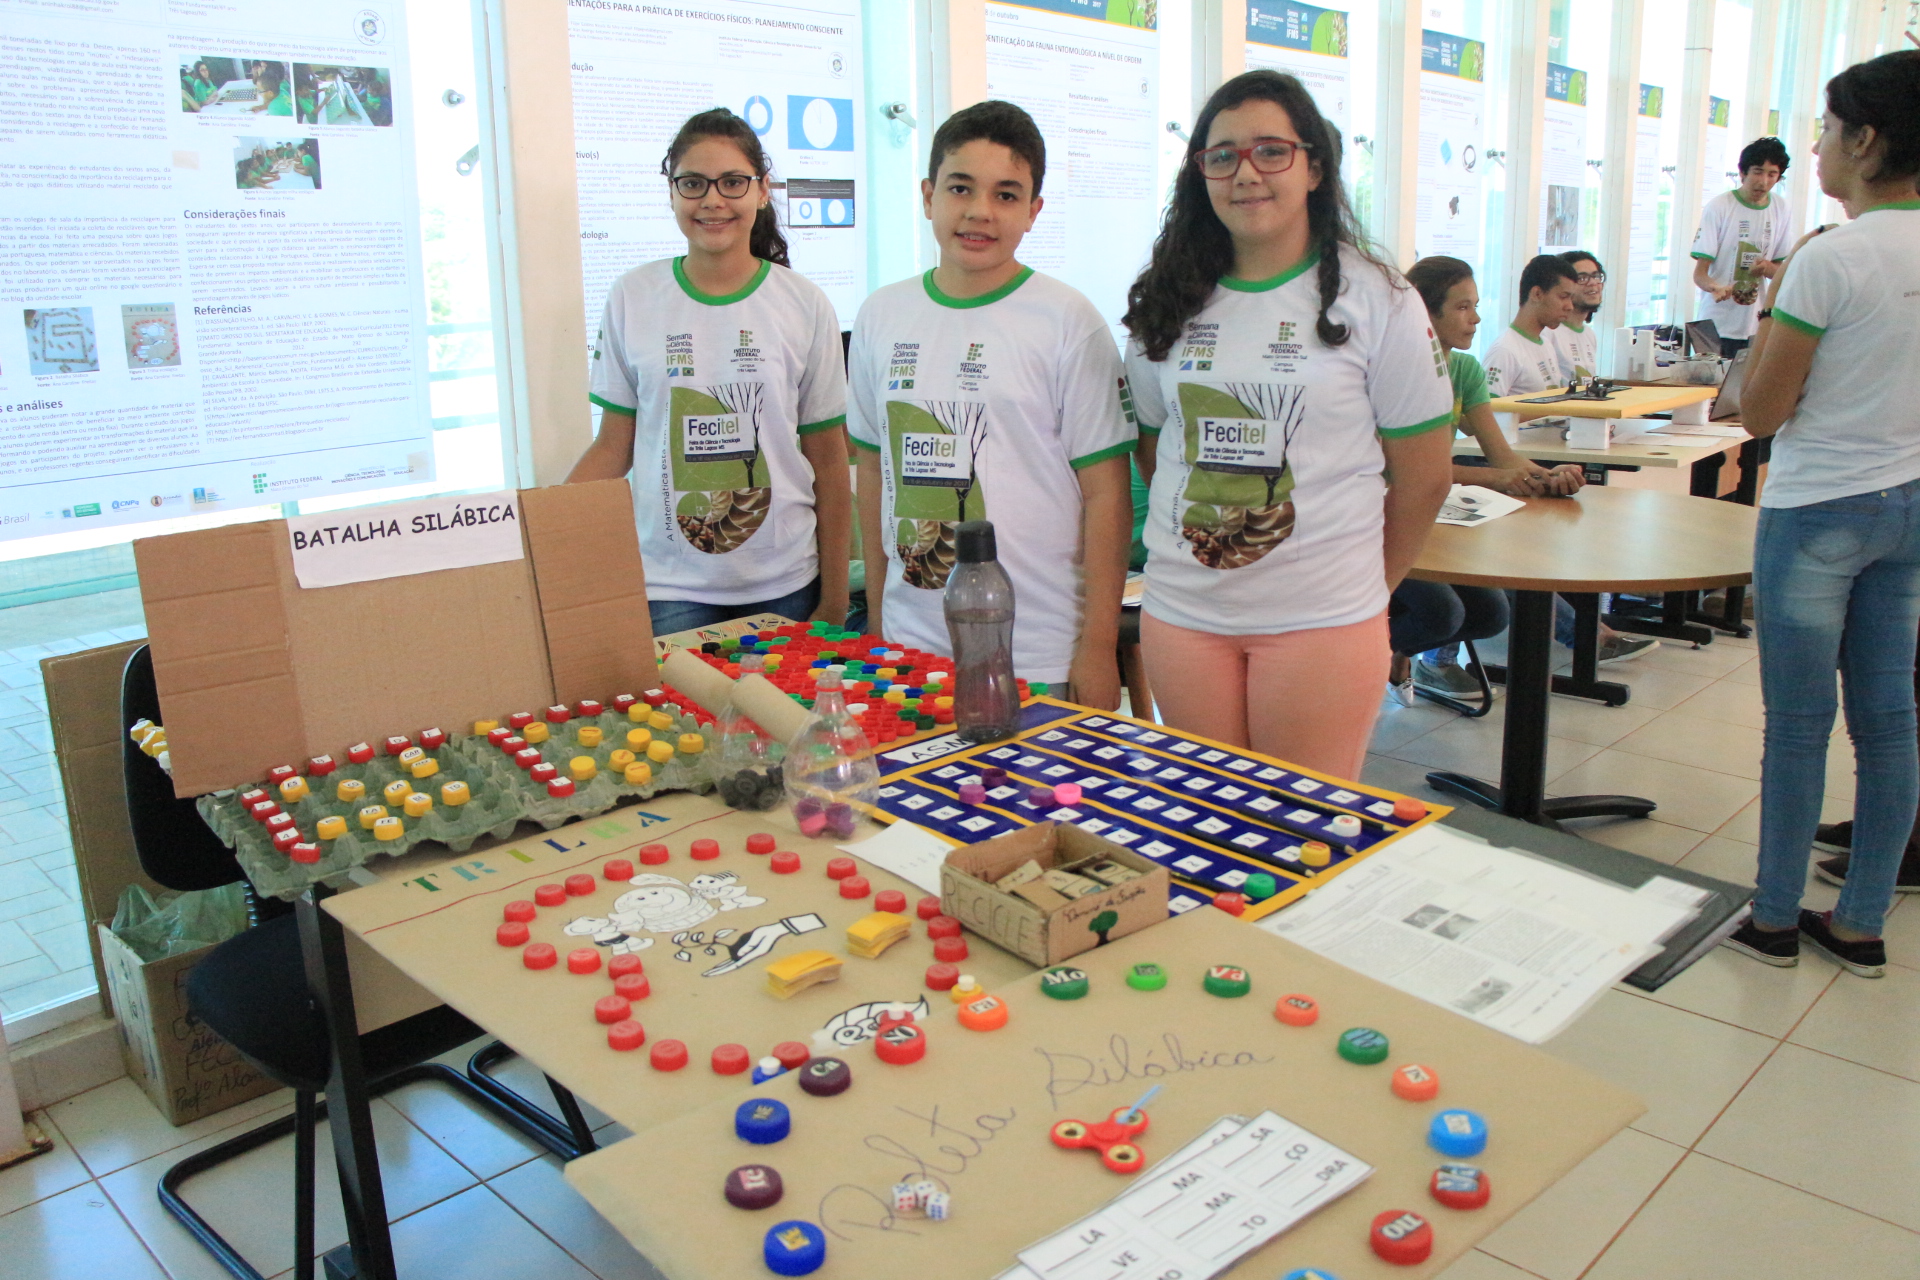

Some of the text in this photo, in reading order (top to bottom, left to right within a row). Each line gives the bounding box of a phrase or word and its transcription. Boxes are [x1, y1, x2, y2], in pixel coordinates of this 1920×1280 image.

[567, 0, 611, 9] IENTAÇÕES
[614, 3, 633, 12] PARA
[643, 6, 672, 16] PRÁTICA
[686, 10, 725, 21] EXERCÍCIOS
[727, 14, 753, 25] FÍSICOS:
[756, 18, 804, 30] PLANEJAMENTO
[806, 24, 843, 35] CONSCIENTE
[1286, 29, 1298, 39] IFMS
[1036, 42, 1053, 51] FAUNA
[1055, 46, 1096, 57] ENTOMOLÓGICA
[1103, 51, 1115, 61] NÍVEL
[1124, 56, 1141, 64] ORDEM
[184, 209, 285, 220] Considerações finais
[194, 304, 252, 315] Referências
[1189, 322, 1219, 331] Semana
[666, 355, 694, 365] IFMS
[1182, 347, 1215, 358] IFMS
[890, 365, 916, 377] IFMS
[17, 400, 63, 412] análises
[688, 417, 739, 436] Fecitel
[1204, 421, 1266, 444] Fecitel
[905, 437, 956, 457] Fecitel
[270, 476, 322, 487] INSTITUTO FEDERAL
[662, 473, 672, 530] Matemática
[4, 513, 30, 525] Brasil
[293, 503, 516, 551] BATALHA SILÁBICA
[404, 750, 420, 758] CAR
[286, 780, 298, 788] ES
[391, 782, 403, 791] LA
[1043, 969, 1086, 985] Mo
[1209, 966, 1246, 981] Va
[970, 997, 999, 1013] ra
[810, 1060, 841, 1076] Ca
[1249, 1126, 1274, 1143] SA
[1284, 1143, 1309, 1163] ÇO
[1315, 1158, 1349, 1182] DRA
[1172, 1171, 1204, 1191] MA
[1204, 1190, 1236, 1212] MA
[1240, 1214, 1267, 1232] TO
[1079, 1228, 1106, 1245] LA
[1111, 1249, 1140, 1269] VE
